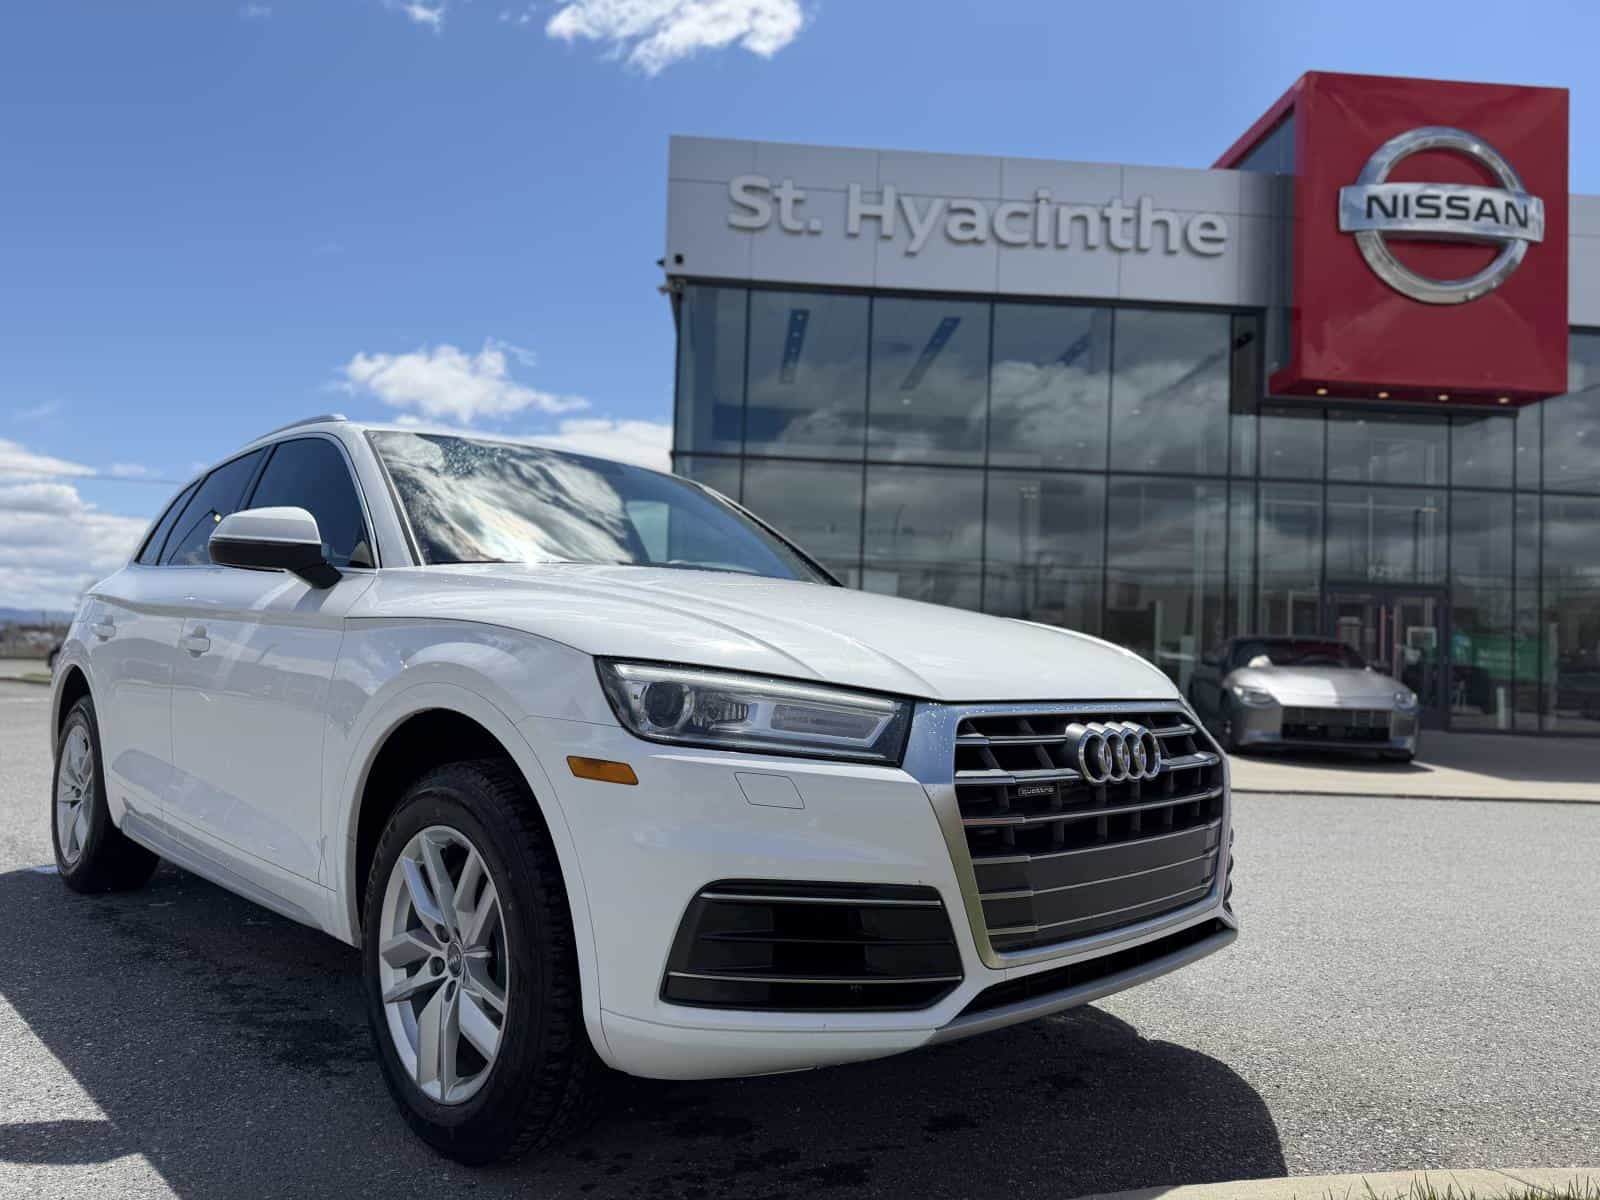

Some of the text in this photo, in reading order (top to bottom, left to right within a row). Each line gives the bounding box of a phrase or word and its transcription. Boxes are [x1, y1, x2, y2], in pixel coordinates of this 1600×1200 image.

[728, 174, 1230, 255] St. Hyacinthe
[1365, 194, 1529, 229] NISSAN
